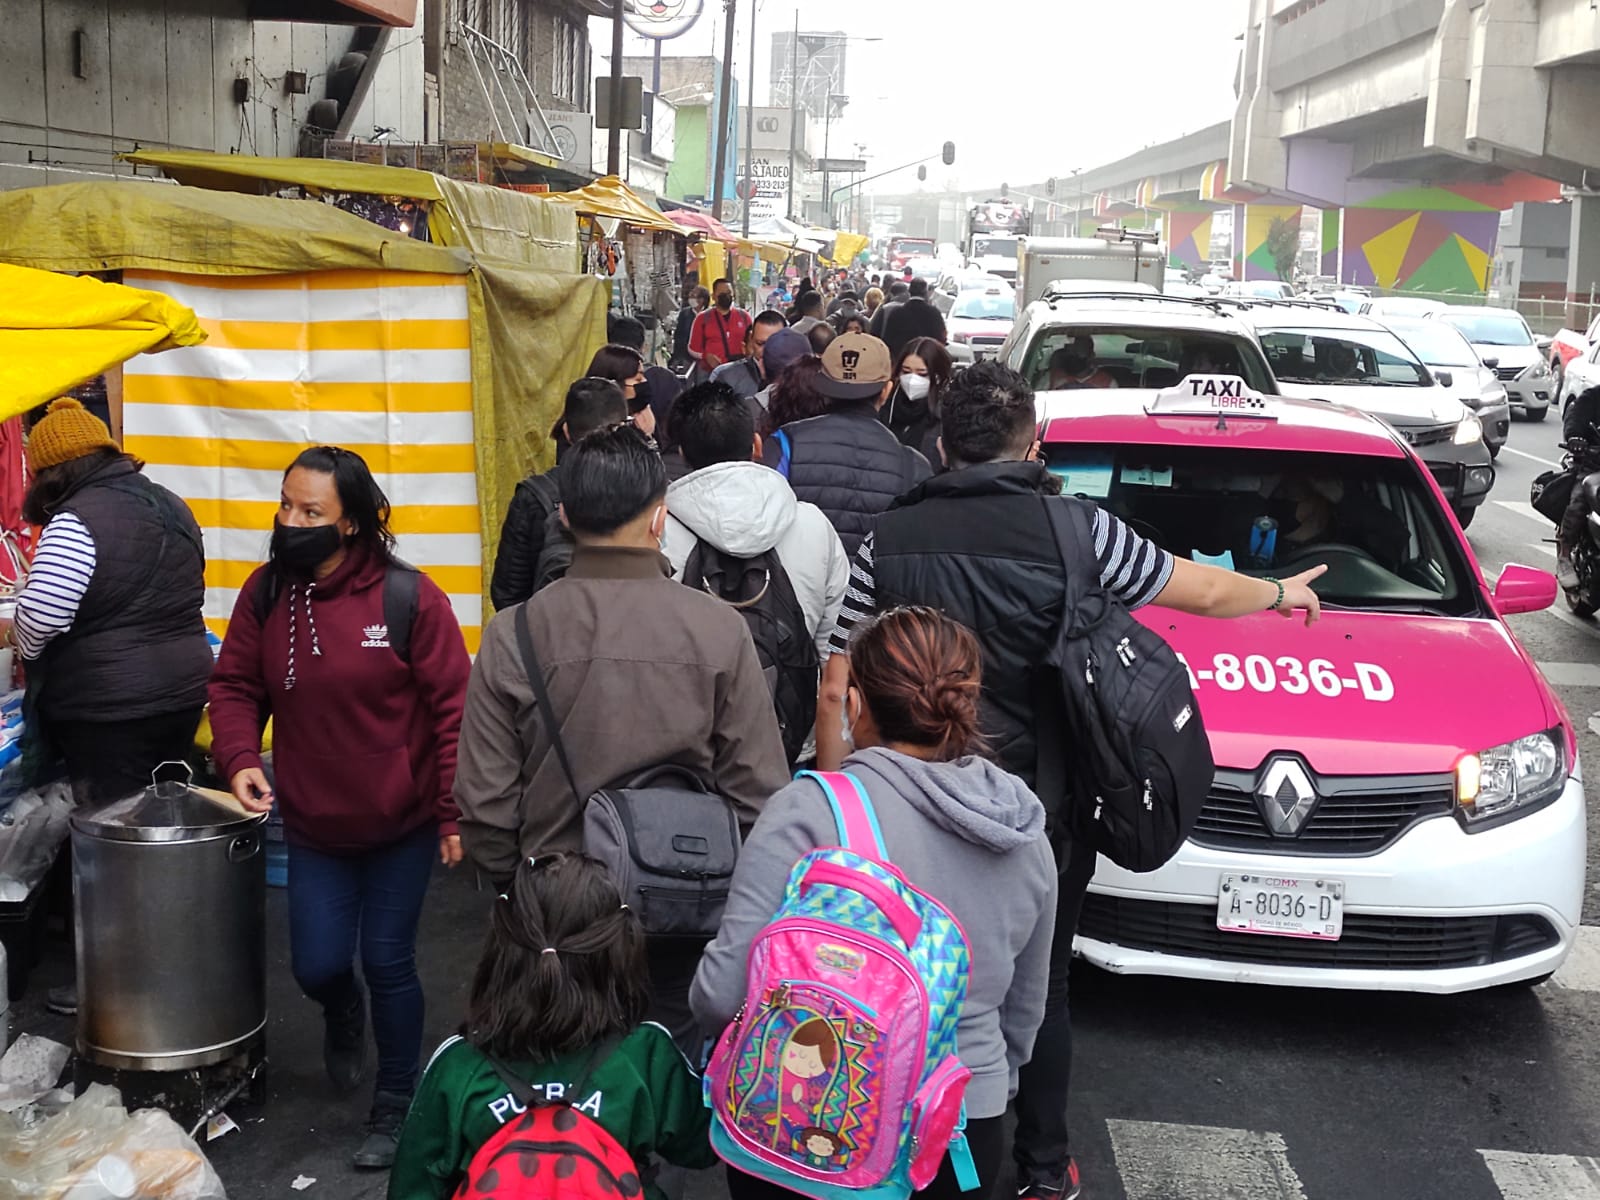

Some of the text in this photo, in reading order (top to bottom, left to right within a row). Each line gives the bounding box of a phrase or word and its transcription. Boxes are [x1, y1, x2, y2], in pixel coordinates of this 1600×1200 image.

[760, 165, 789, 178] TADEO
[1189, 379, 1242, 397] TAXI
[1211, 396, 1246, 409] LIBRE
[1265, 877, 1298, 888] CDMX
[1230, 891, 1332, 921] A-8036-D
[487, 1082, 603, 1124] PUBA
